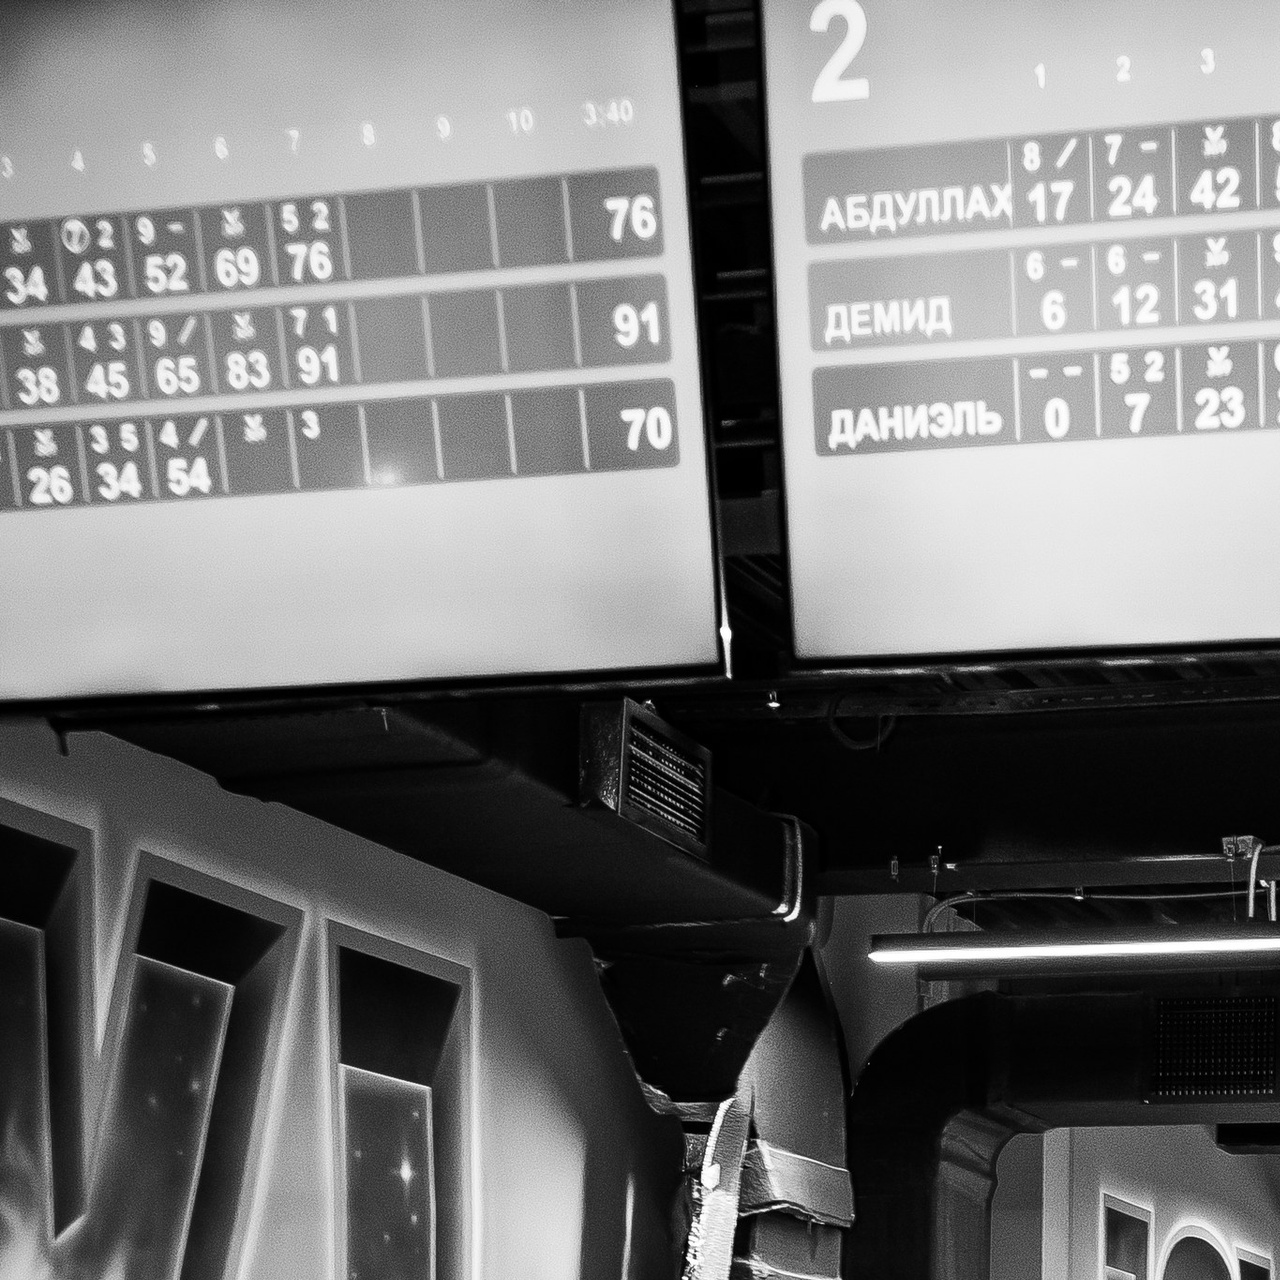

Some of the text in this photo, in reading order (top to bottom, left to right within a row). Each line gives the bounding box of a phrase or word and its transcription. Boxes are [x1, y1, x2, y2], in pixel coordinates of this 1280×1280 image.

[809, 0, 870, 103] 2
[1034, 63, 1046, 89] 1
[1116, 55, 1131, 83] 2
[1200, 47, 1216, 75] 3
[71, 150, 85, 172] 4
[508, 108, 534, 132] 10
[1022, 141, 1041, 172] 8
[1104, 133, 1123, 166] 7
[96, 219, 114, 249] 2
[136, 216, 155, 245] 9
[281, 203, 300, 233] 5
[311, 201, 330, 231] 2
[820, 182, 1013, 235] АБДУЛЛАХ
[1027, 180, 1074, 223] 17
[1108, 174, 1158, 217] 24
[1189, 166, 1241, 210] 42
[4, 194, 657, 305] 34 43 52 69 76 76
[1025, 251, 1045, 281] 6
[1107, 244, 1126, 275] 6
[109, 322, 127, 351] 3
[148, 319, 167, 348] 9
[290, 307, 308, 337] 7
[323, 306, 338, 334] 1
[824, 295, 954, 344] ДЕМИД
[1041, 290, 1067, 331] 6
[1112, 283, 1160, 326] 12
[1193, 278, 1238, 321] 31
[17, 301, 661, 406] 38 45 65 83 91 91
[1110, 352, 1131, 385] 5
[1144, 350, 1165, 383] 2
[90, 425, 110, 454] 3
[120, 422, 139, 452] 5
[159, 420, 179, 449] 4
[301, 409, 321, 440] 3
[828, 400, 1003, 450] ДАНИЭЛЬ
[1044, 397, 1070, 439] 0
[1124, 392, 1151, 434] 7
[1194, 386, 1246, 430] 23
[27, 406, 673, 505] 26 34 54 70
